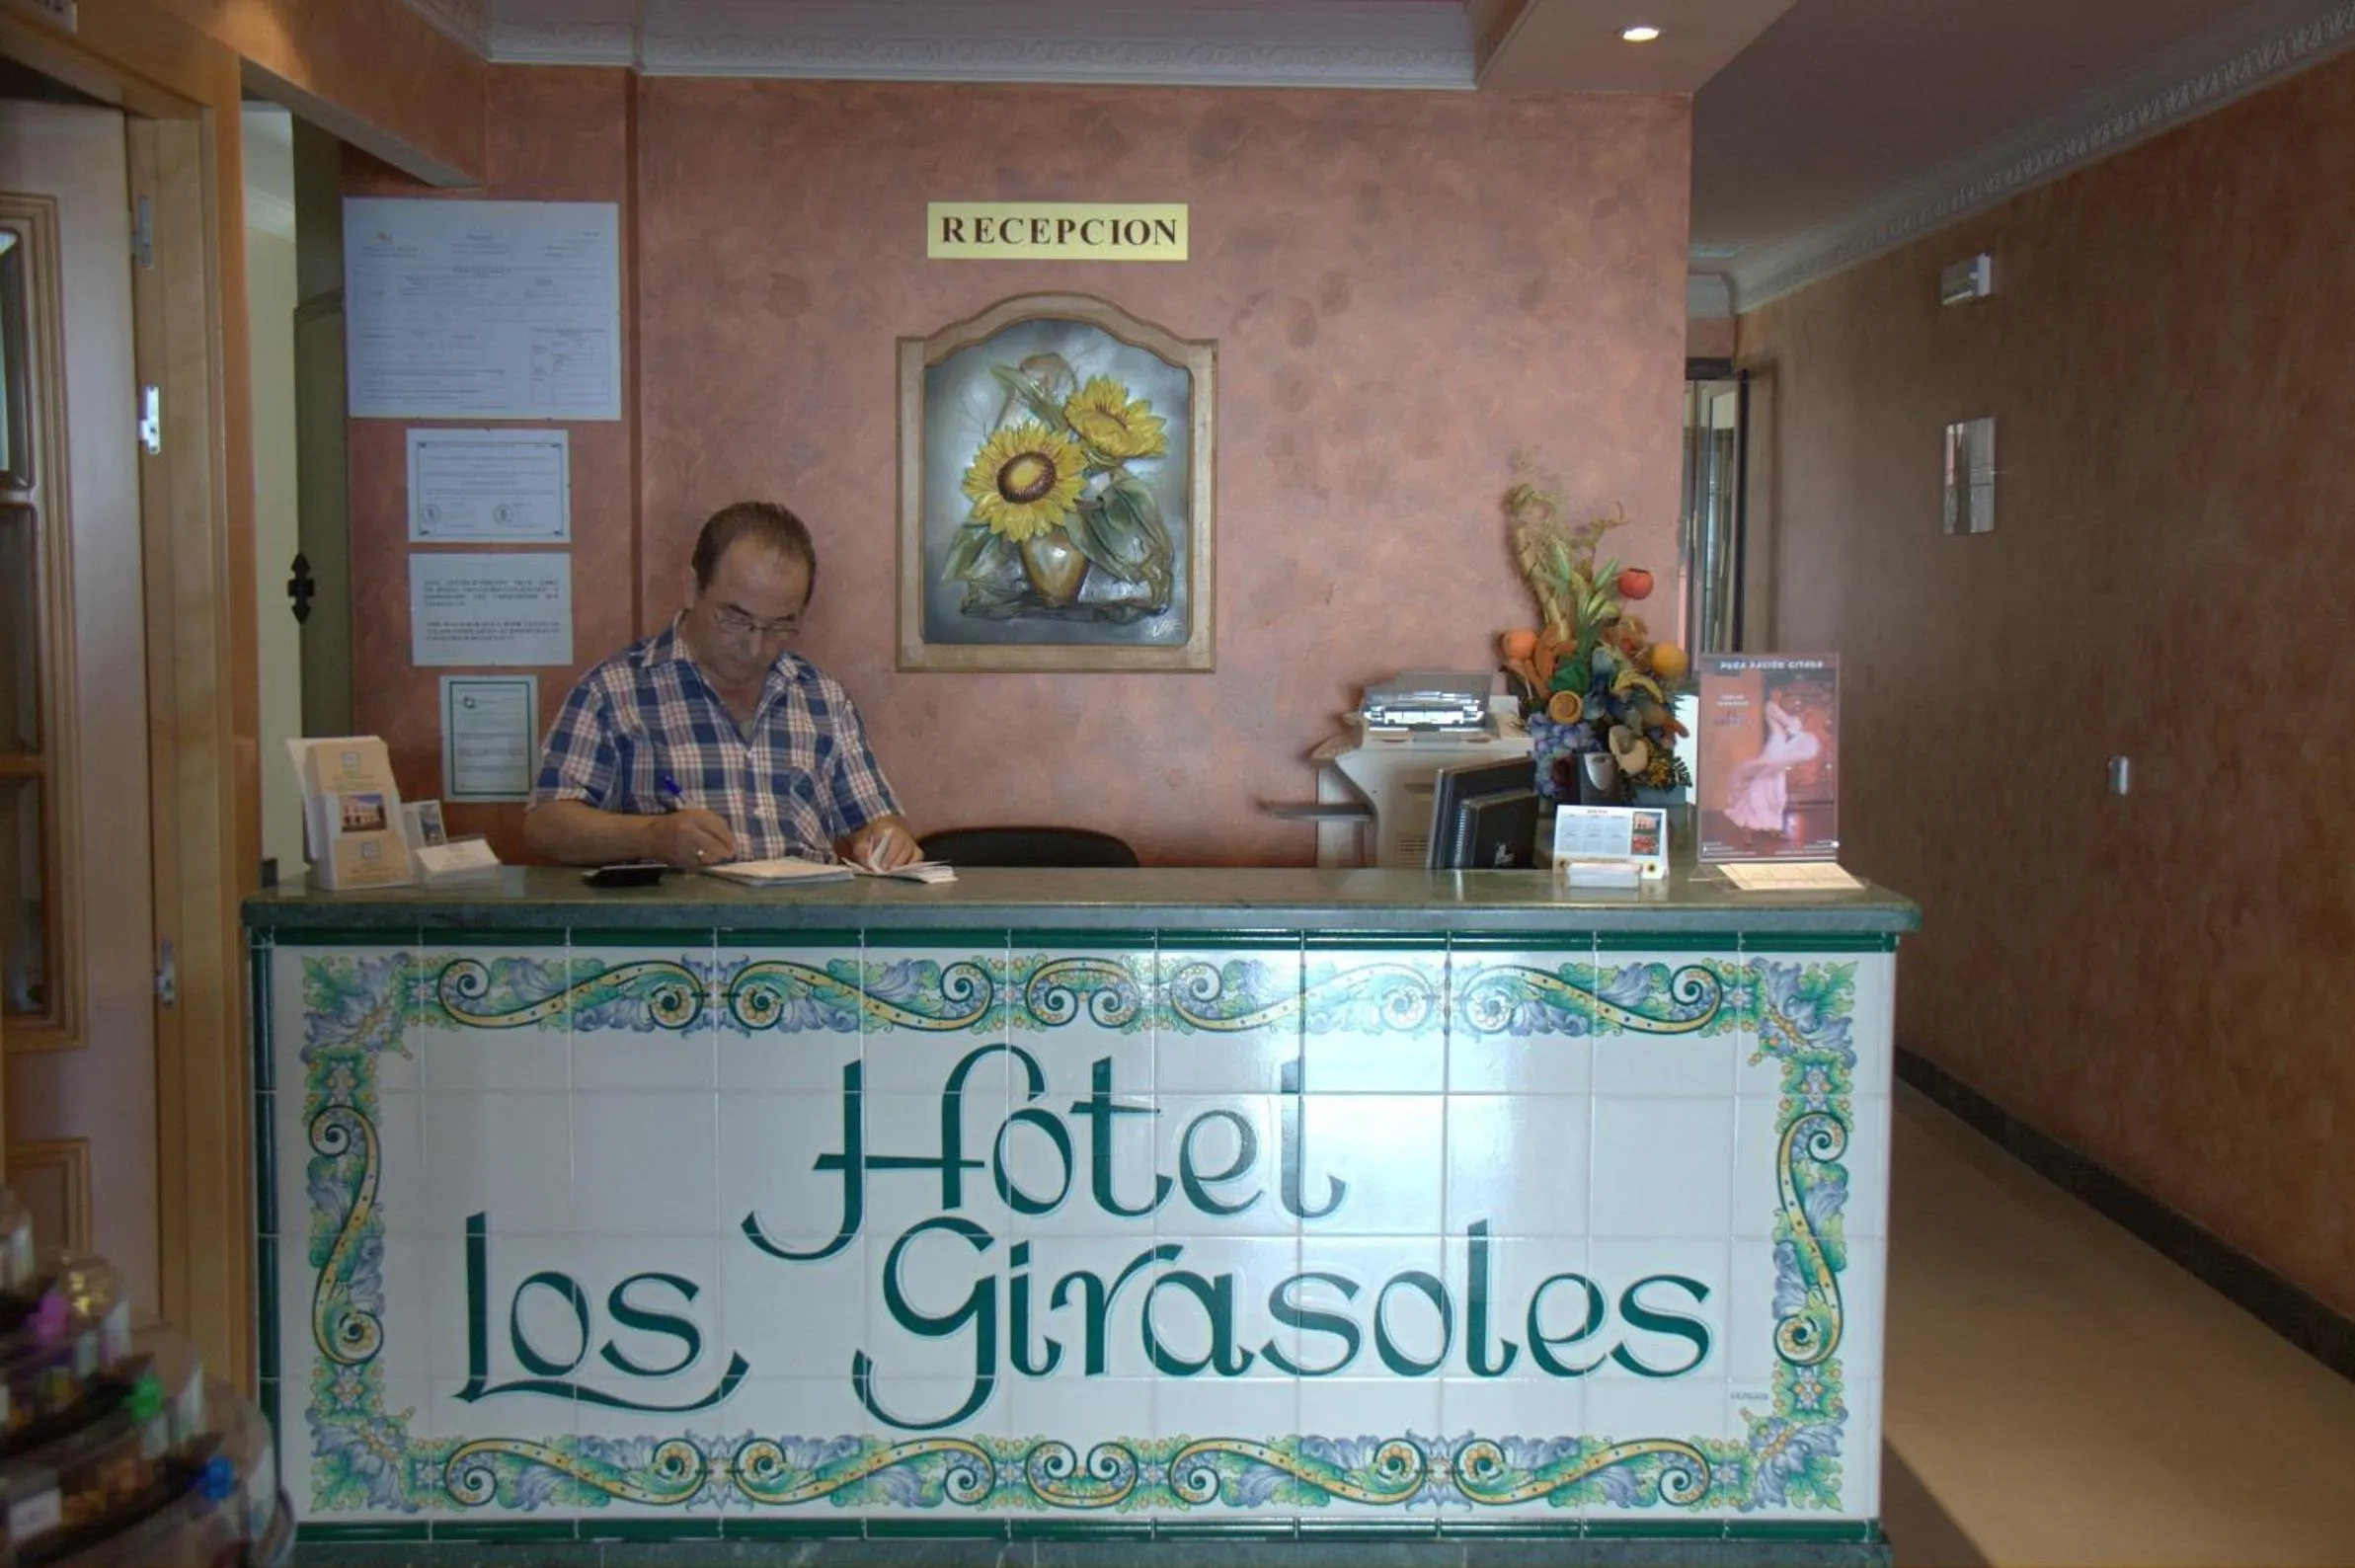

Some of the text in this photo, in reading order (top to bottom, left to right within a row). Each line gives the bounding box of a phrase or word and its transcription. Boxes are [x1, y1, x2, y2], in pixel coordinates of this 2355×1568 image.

[941, 216, 1178, 246] RECEPCION
[740, 1042, 1348, 1261] Hotel
[451, 1211, 1712, 1431] Los Girasoles
